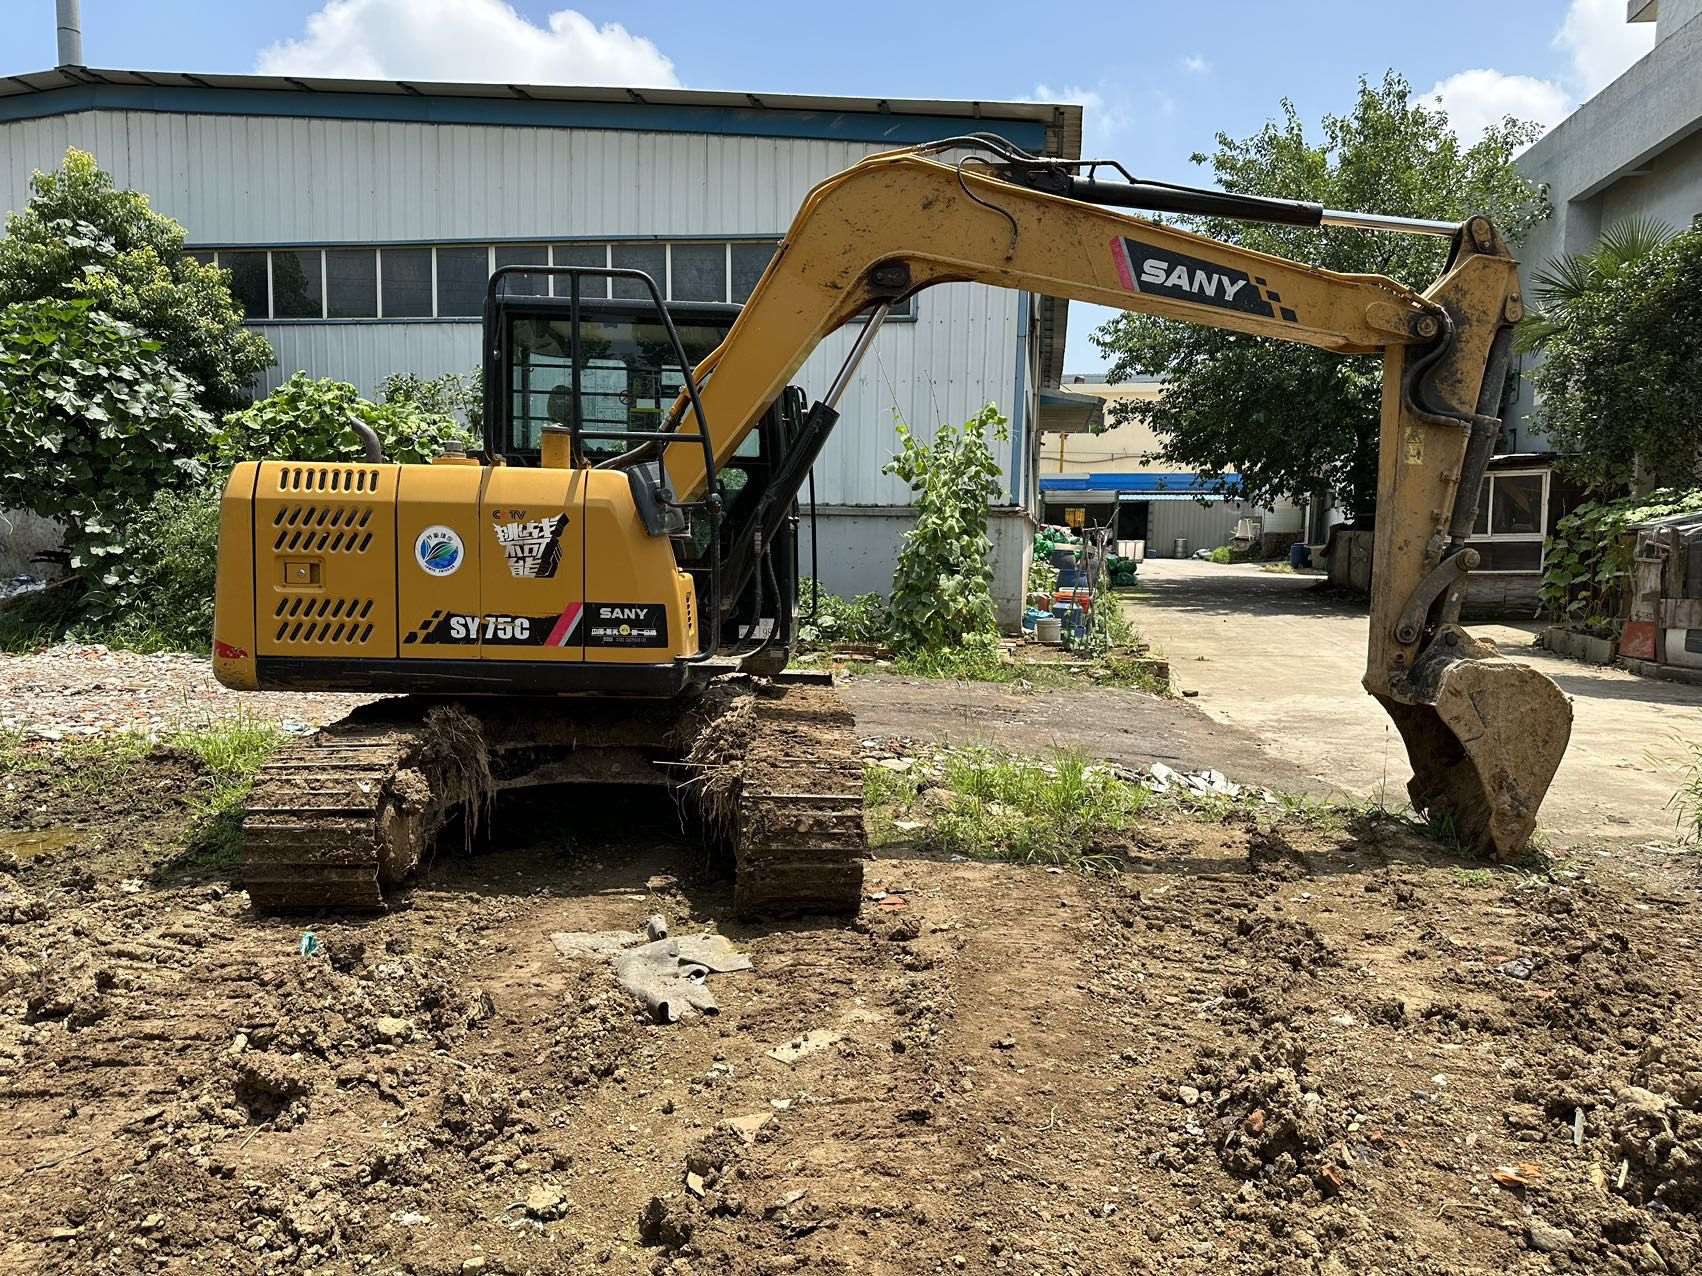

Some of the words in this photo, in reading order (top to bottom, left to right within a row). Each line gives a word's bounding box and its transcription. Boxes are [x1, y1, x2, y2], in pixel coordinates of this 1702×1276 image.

[1140, 258, 1248, 301] SANY
[492, 509, 526, 520] CCTV
[493, 515, 560, 542] 挑战
[500, 539, 552, 559] 不可
[507, 556, 542, 578] 能
[599, 607, 648, 620] SANY
